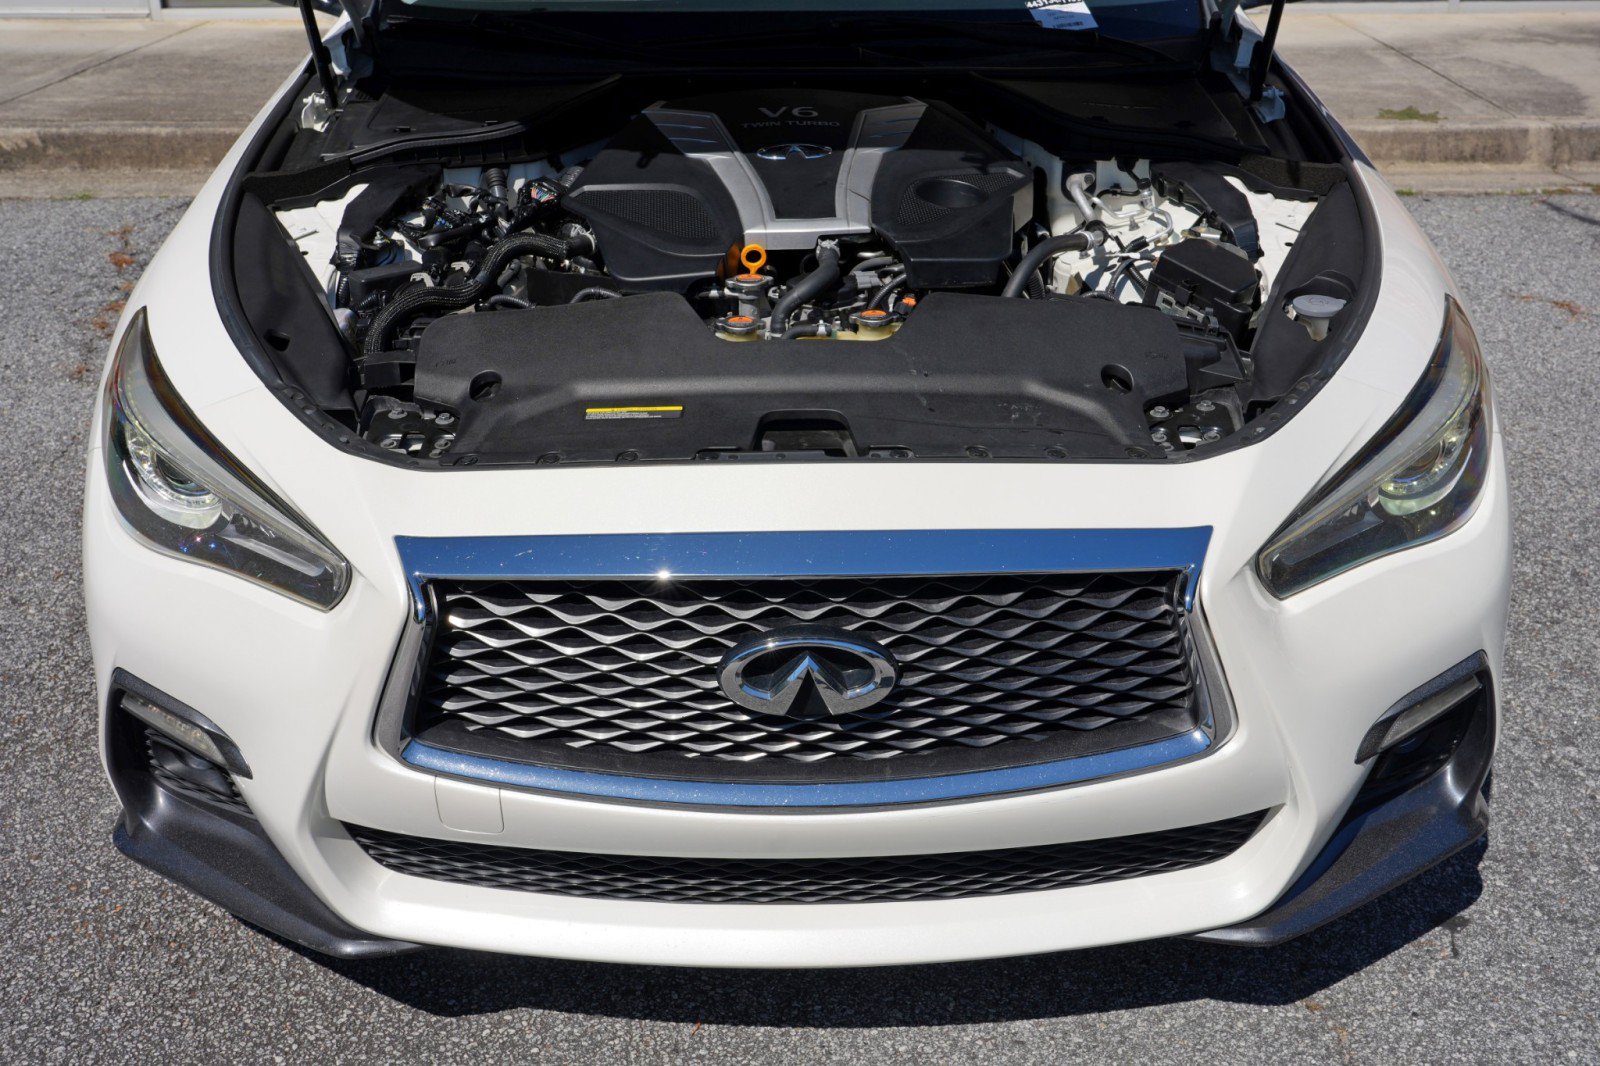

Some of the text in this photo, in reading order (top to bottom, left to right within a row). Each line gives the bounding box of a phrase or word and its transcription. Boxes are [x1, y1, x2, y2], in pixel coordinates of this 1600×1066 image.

[757, 106, 819, 118] V6
[740, 120, 840, 129] TWIN TURBO
